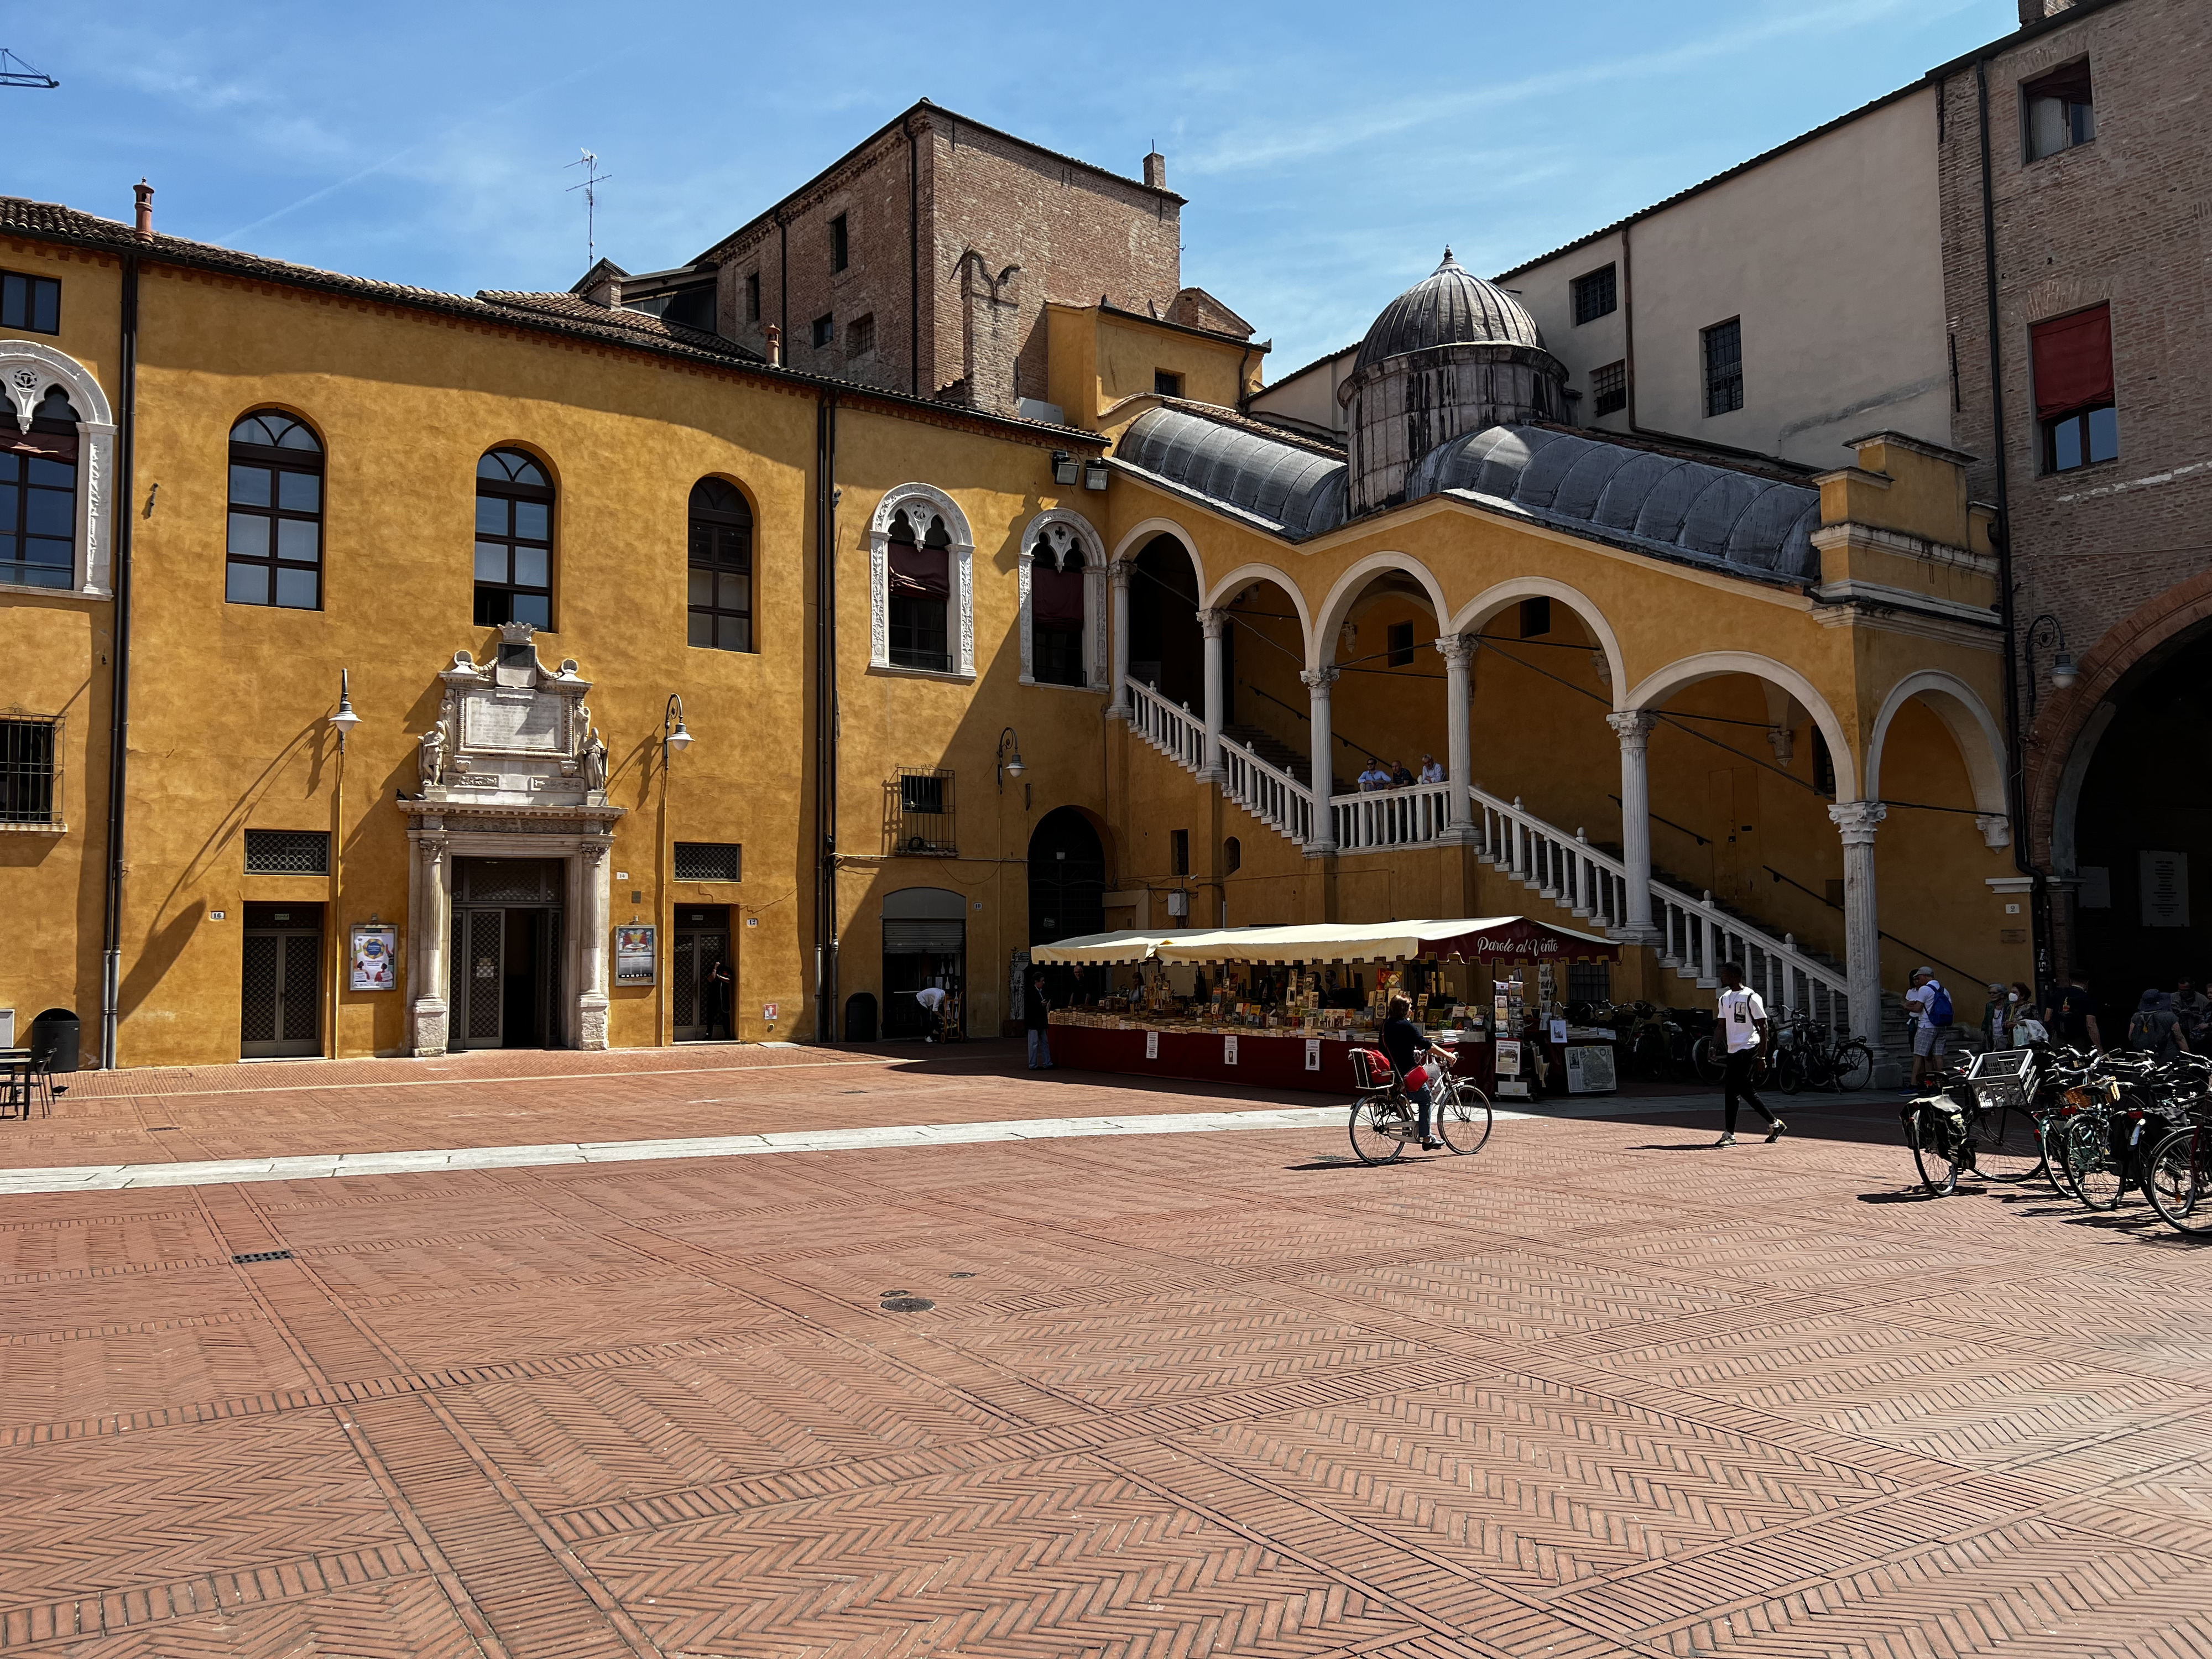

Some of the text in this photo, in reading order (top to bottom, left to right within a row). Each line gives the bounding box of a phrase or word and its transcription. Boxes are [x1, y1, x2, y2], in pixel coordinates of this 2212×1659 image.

[1477, 936, 1559, 957] Parole al Vento
